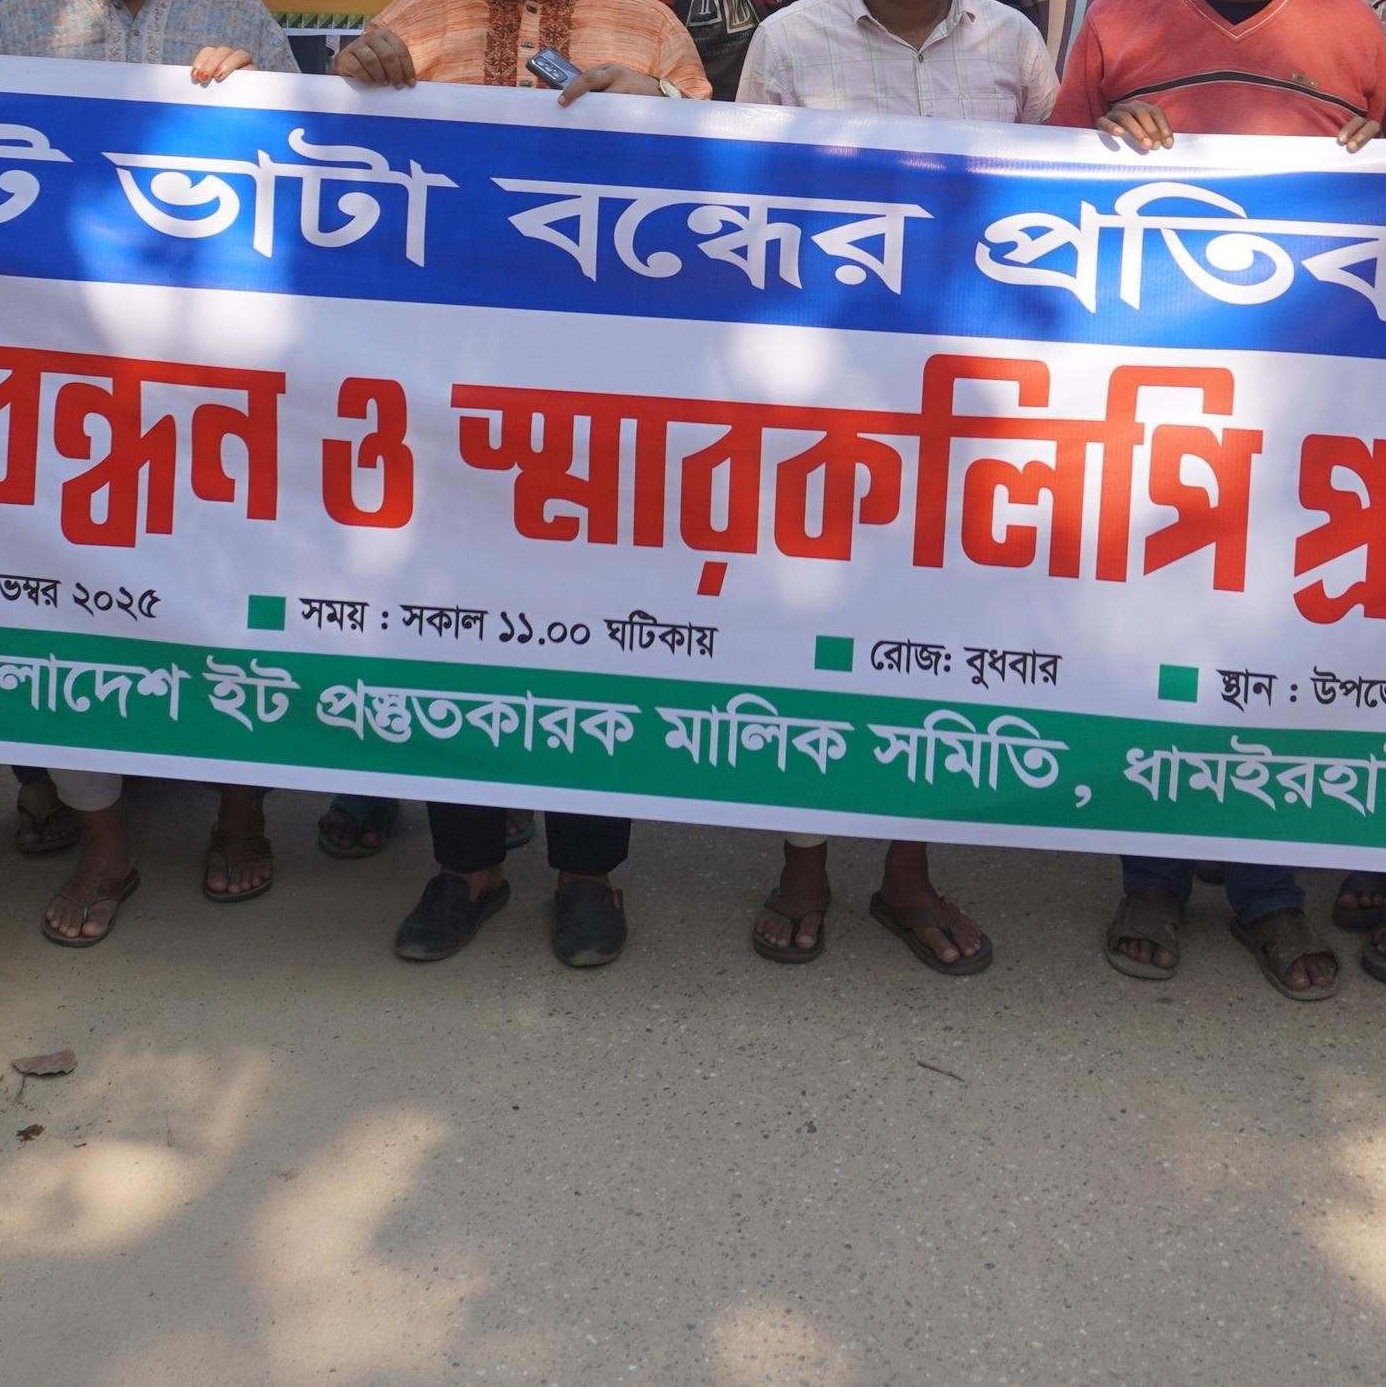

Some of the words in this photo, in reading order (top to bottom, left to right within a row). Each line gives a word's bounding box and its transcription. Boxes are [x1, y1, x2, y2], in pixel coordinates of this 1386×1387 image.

[101, 125, 460, 270] ভাটা
[490, 173, 934, 295] বন্ধের
[320, 377, 416, 530] ও
[451, 352, 1262, 598] স্মারকলিপি
[73, 586, 162, 620] ২০২৫
[299, 597, 369, 634] সময়
[400, 603, 489, 642] সকাল
[498, 611, 591, 648] ১১.০০
[605, 609, 719, 659] ঘটিকায়
[869, 639, 953, 677] রোজ:
[964, 646, 1062, 688] বুধবার
[1216, 667, 1278, 710] স্থান
[202, 654, 301, 732] ইট
[315, 676, 643, 759] প্রস্তুতকারক
[655, 692, 854, 776] মালিক
